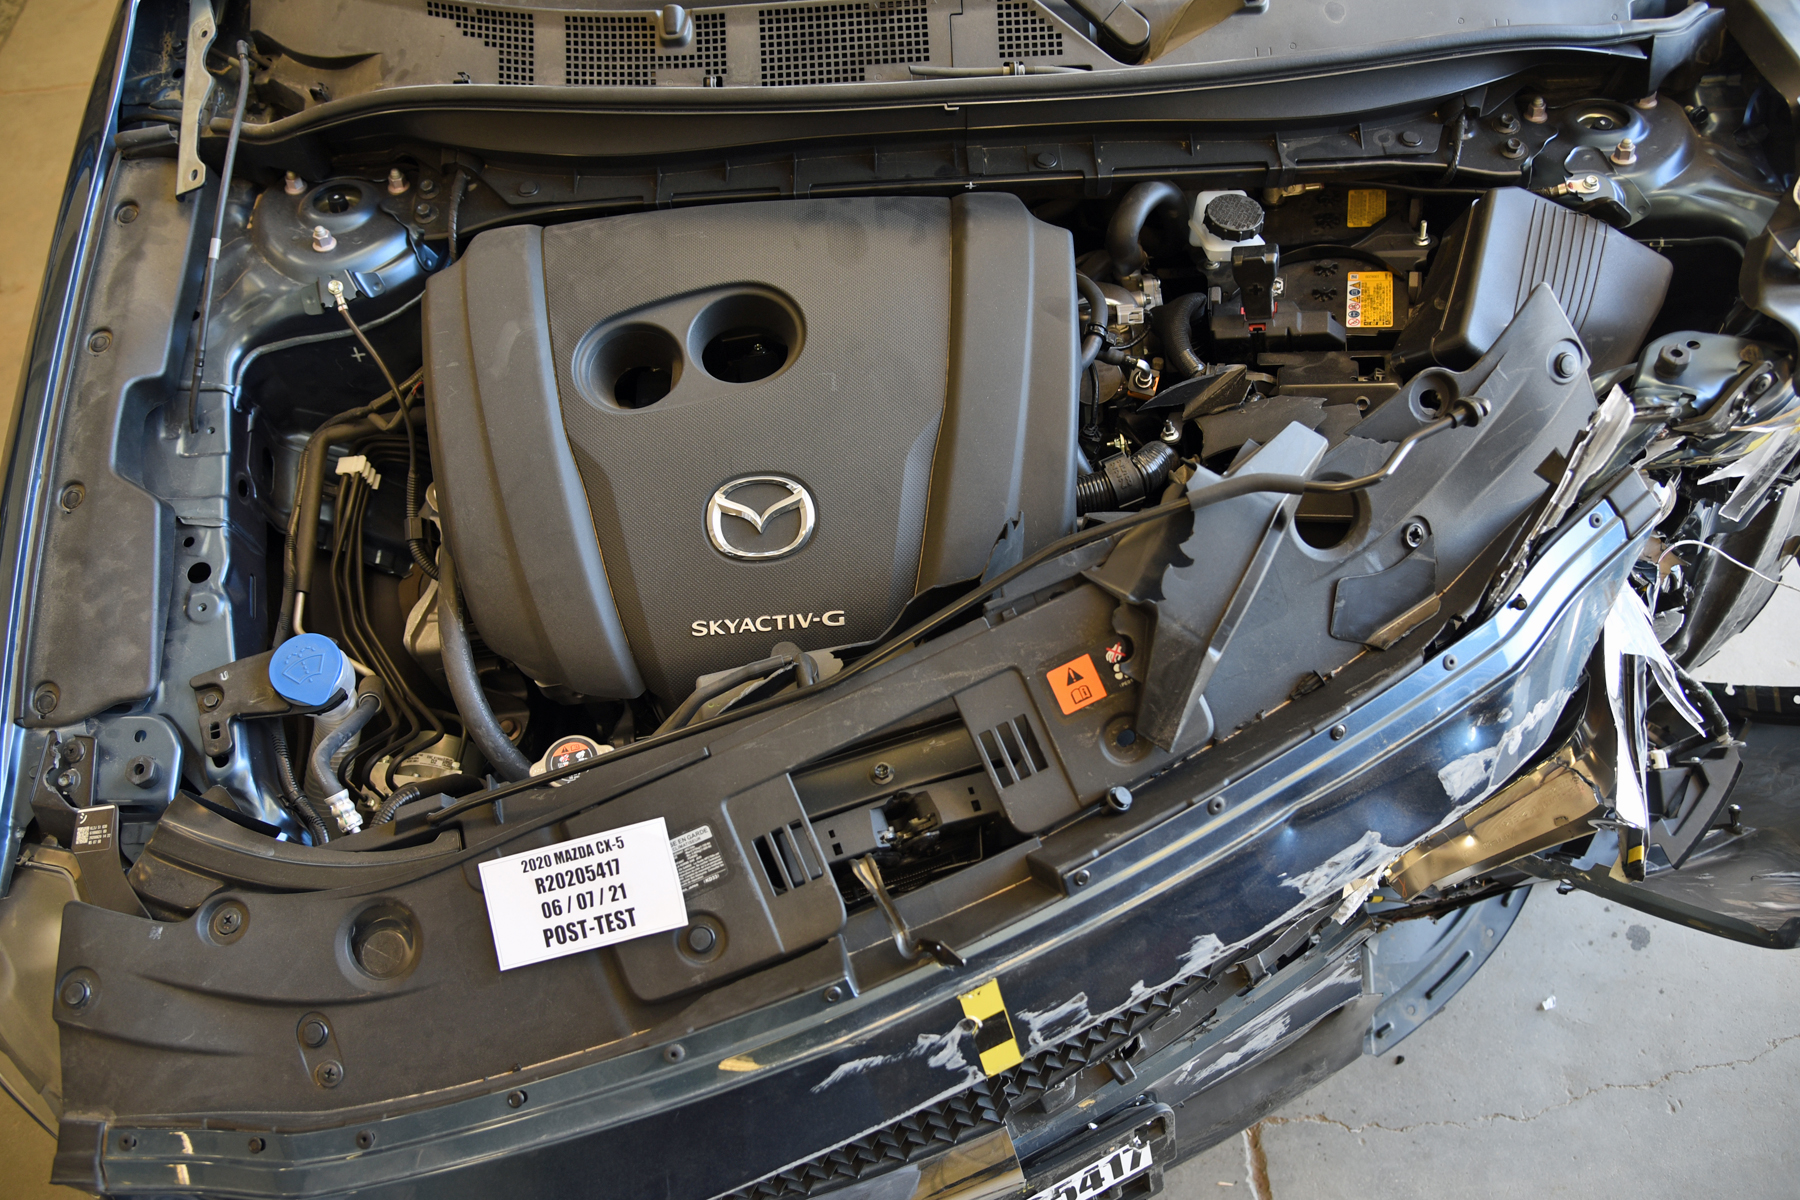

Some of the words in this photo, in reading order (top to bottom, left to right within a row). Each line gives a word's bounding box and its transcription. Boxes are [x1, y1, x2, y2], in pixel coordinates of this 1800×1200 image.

[691, 610, 846, 637] SKYACTIV-G
[687, 828, 708, 840] GARDE
[520, 854, 552, 873] 2020
[553, 844, 595, 864] MAZDA
[596, 836, 625, 853] CX-5
[535, 858, 621, 895] R20205417
[541, 899, 563, 919] 06
[577, 891, 594, 911] 07
[609, 883, 628, 903] 21
[543, 907, 637, 948] POST-TEST
[1031, 1147, 1142, 1200] 5417
